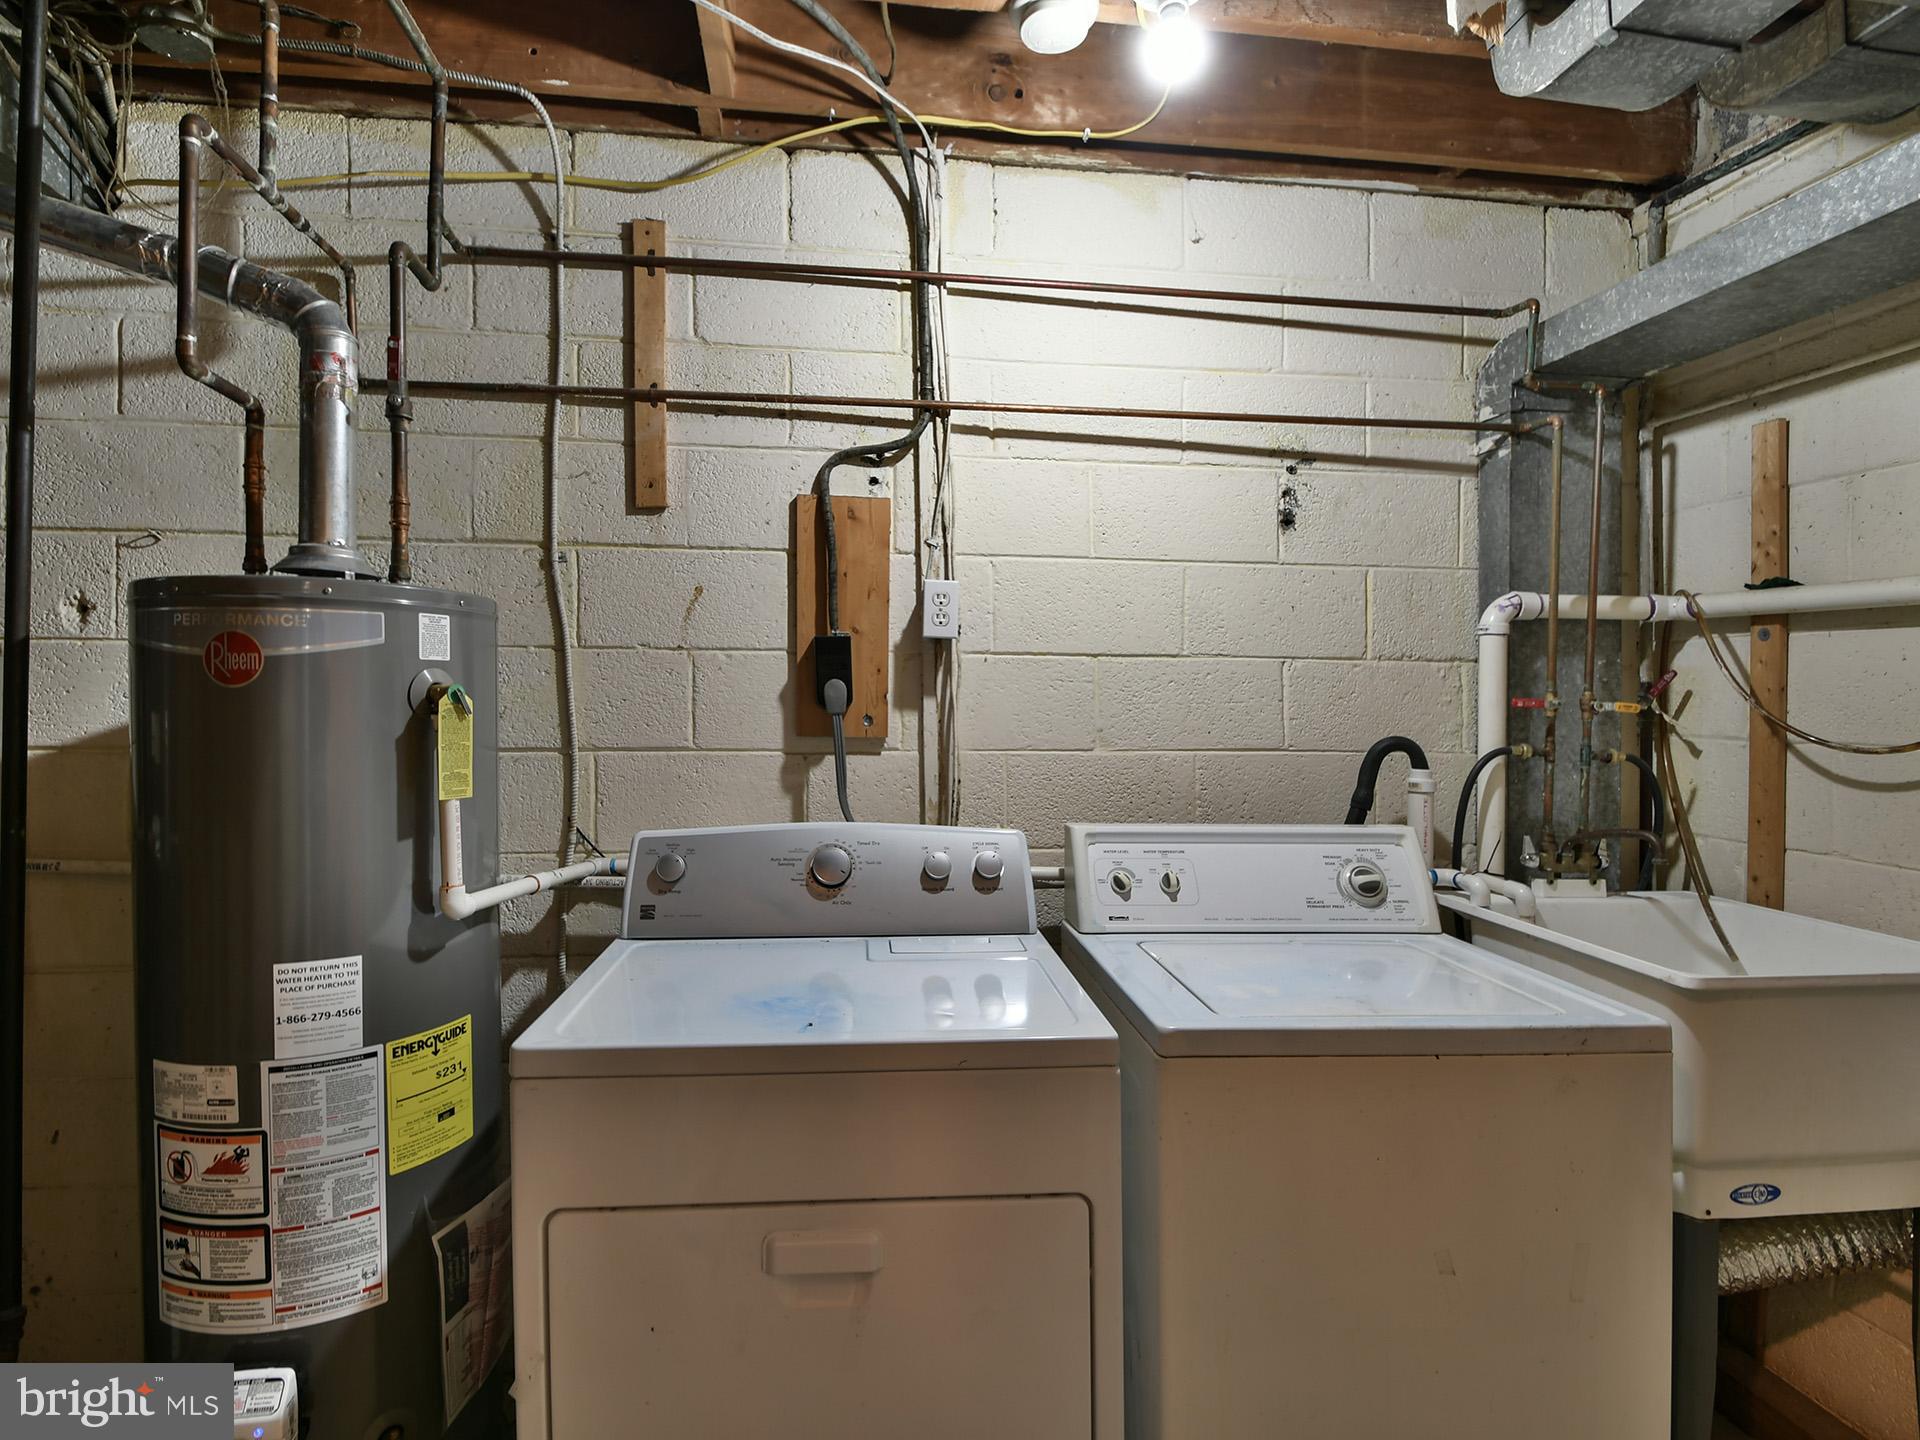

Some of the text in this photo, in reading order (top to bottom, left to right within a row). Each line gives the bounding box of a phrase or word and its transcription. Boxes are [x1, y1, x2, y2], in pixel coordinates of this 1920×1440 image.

[173, 612, 306, 627] PERFORMANCE
[210, 631, 259, 678] Rheem
[310, 964, 340, 972] RETURN
[304, 974, 332, 982] HEATER
[317, 980, 356, 990] PURCHASE
[276, 1007, 361, 1025] 1-866-279-4566
[392, 1022, 467, 1060] ENERGYGUIDE
[435, 1060, 463, 1080] $231
[188, 1136, 228, 1145] WARNING
[194, 1230, 227, 1238] DANGER
